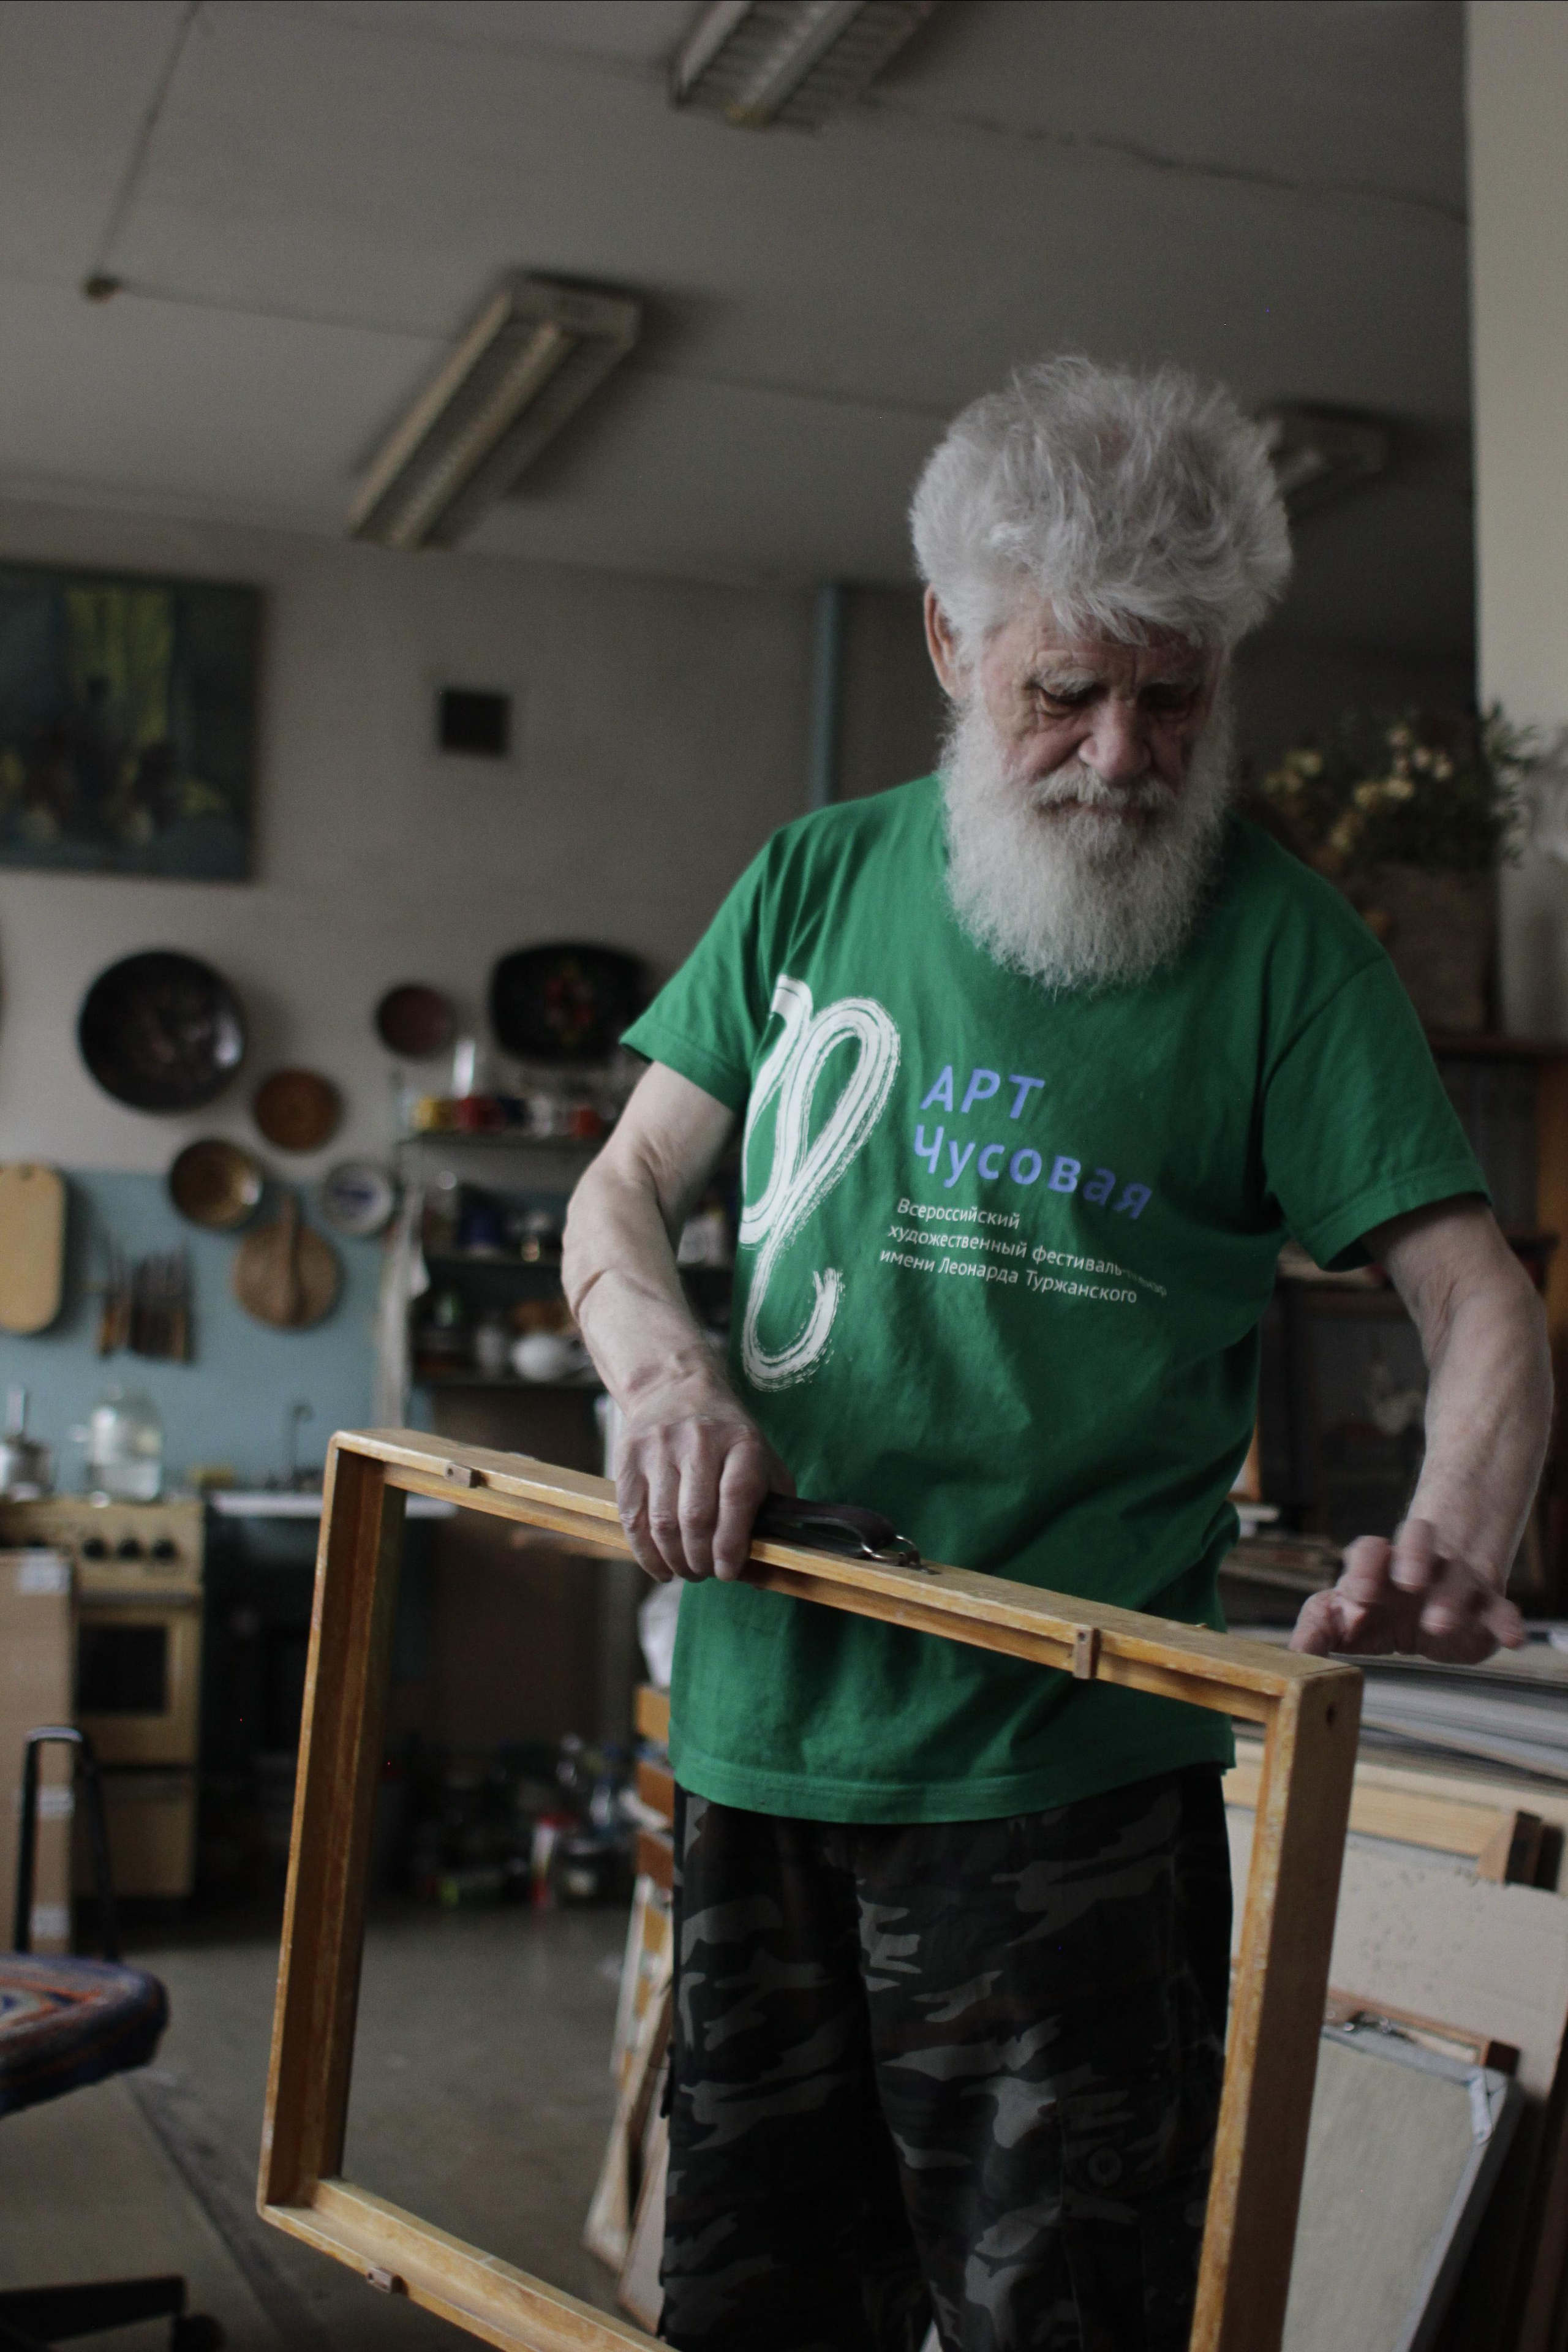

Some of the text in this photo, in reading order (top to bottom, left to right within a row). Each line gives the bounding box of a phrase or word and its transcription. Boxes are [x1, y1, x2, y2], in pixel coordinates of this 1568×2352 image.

[920, 1065, 1045, 1120] АРТ
[914, 1125, 1152, 1219] Чусовая
[888, 1224, 1027, 1259] художественный
[897, 1198, 1020, 1230] Всероссийский
[880, 1249, 1137, 1304] имени Леонарда Туржанского
